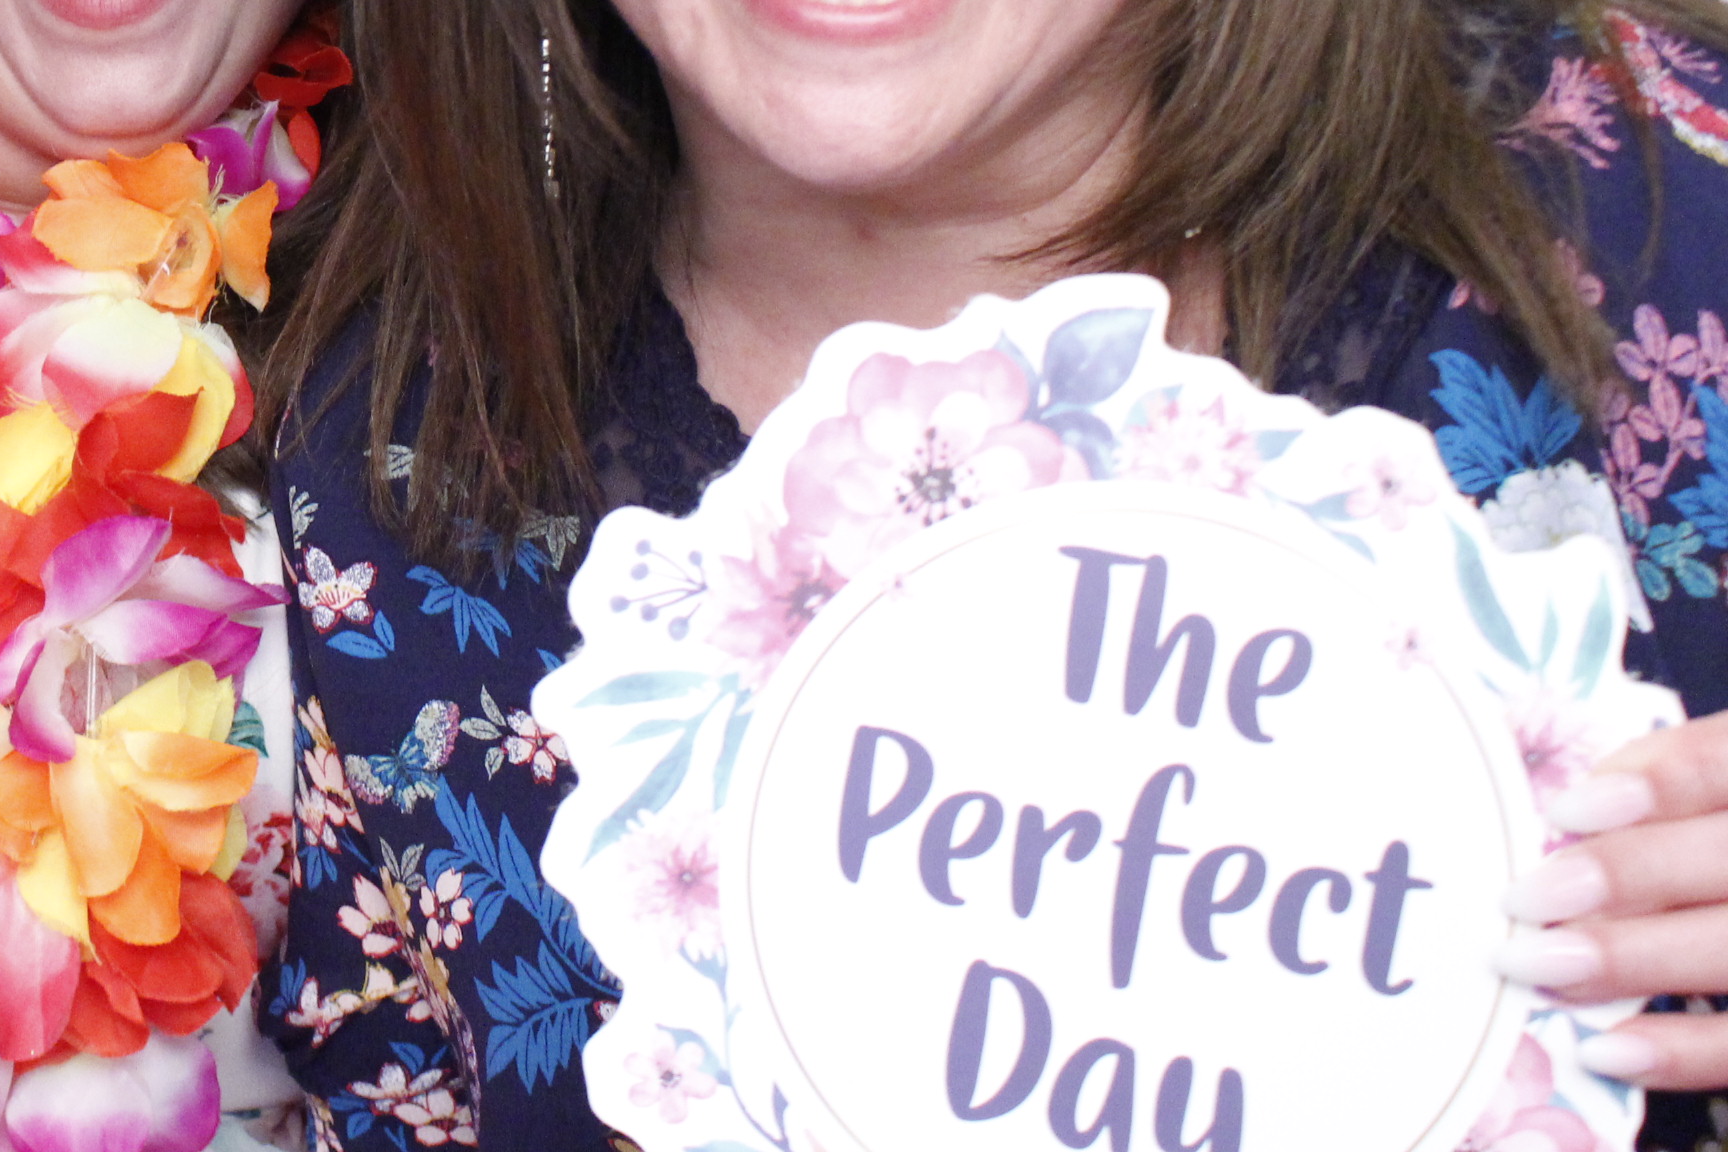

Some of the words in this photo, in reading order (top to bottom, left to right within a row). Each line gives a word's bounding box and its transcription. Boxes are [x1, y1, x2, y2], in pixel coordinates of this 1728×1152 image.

[1059, 545, 1313, 744] The
[837, 725, 1434, 997] Perfect
[945, 959, 1245, 1152] Day
